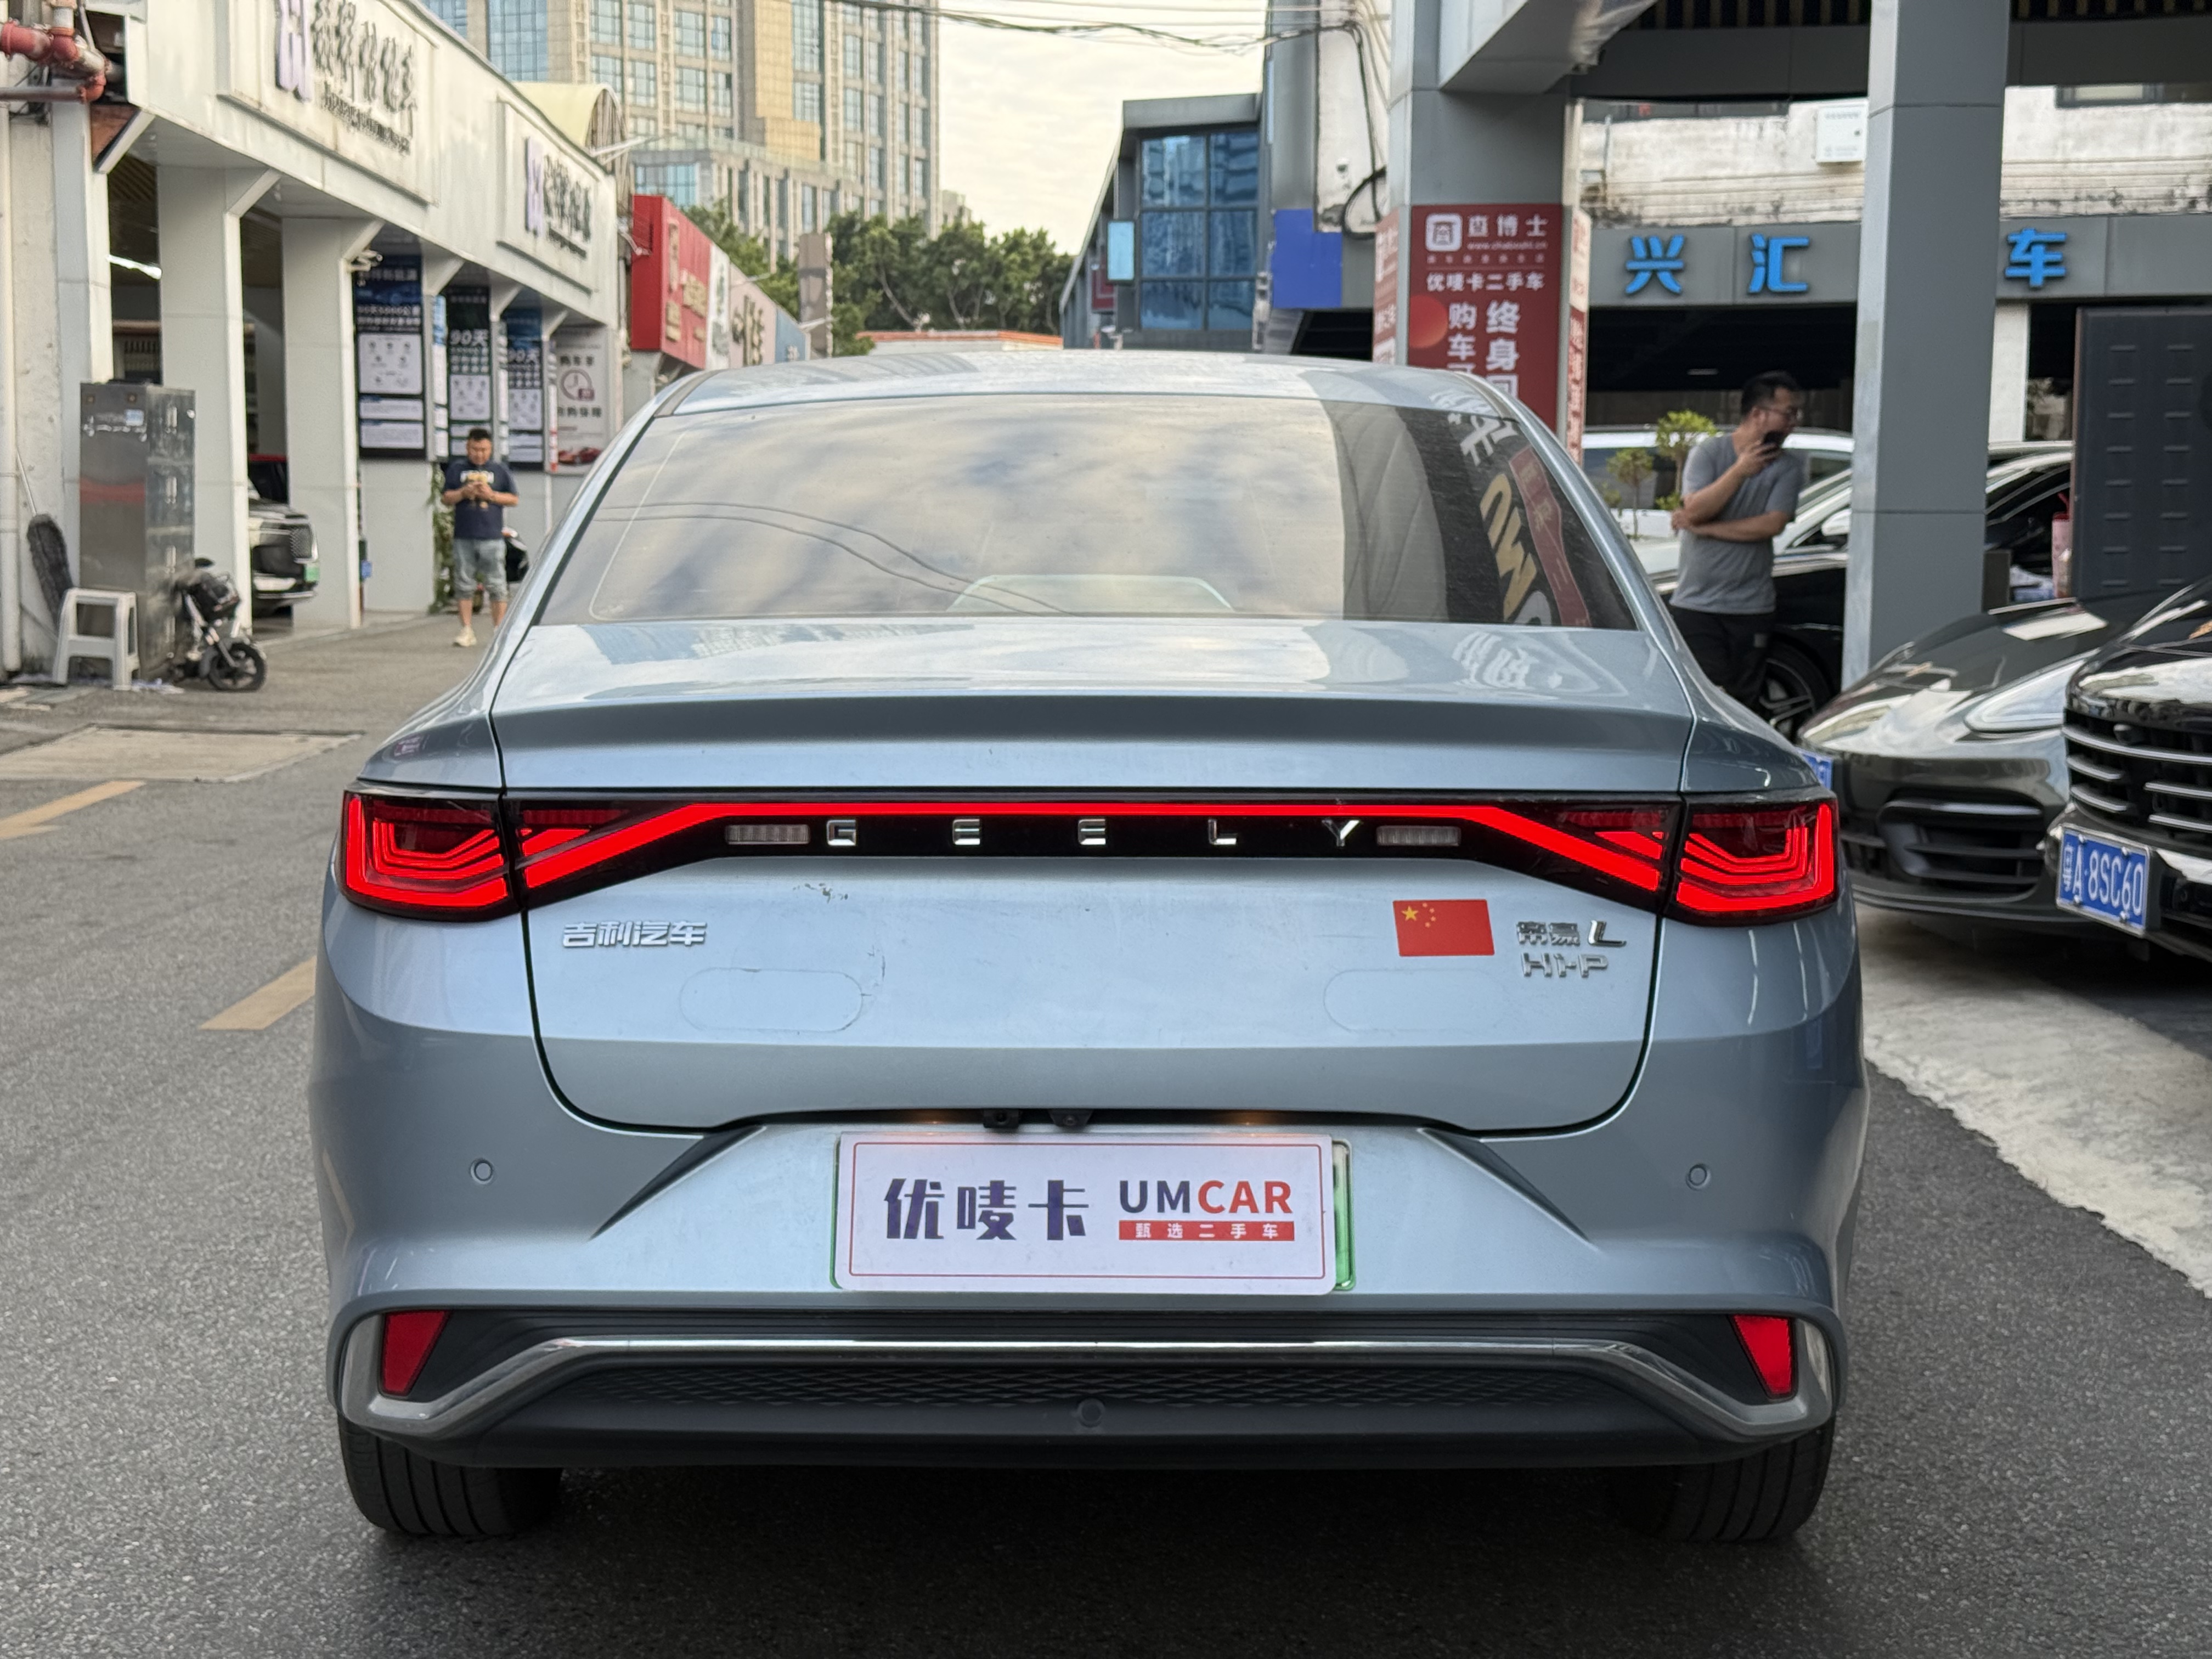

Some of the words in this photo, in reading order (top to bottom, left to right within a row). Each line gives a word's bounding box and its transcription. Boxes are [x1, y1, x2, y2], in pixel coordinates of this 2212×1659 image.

[1427, 272, 1545, 292] 优唛卡二手车
[826, 818, 1362, 847] GEELY
[562, 921, 708, 947] 吉利汽车
[884, 1178, 1089, 1241] 优唛卡
[1120, 1180, 1293, 1214] UMCAR
[1135, 1222, 1279, 1239] 甄选二手车
